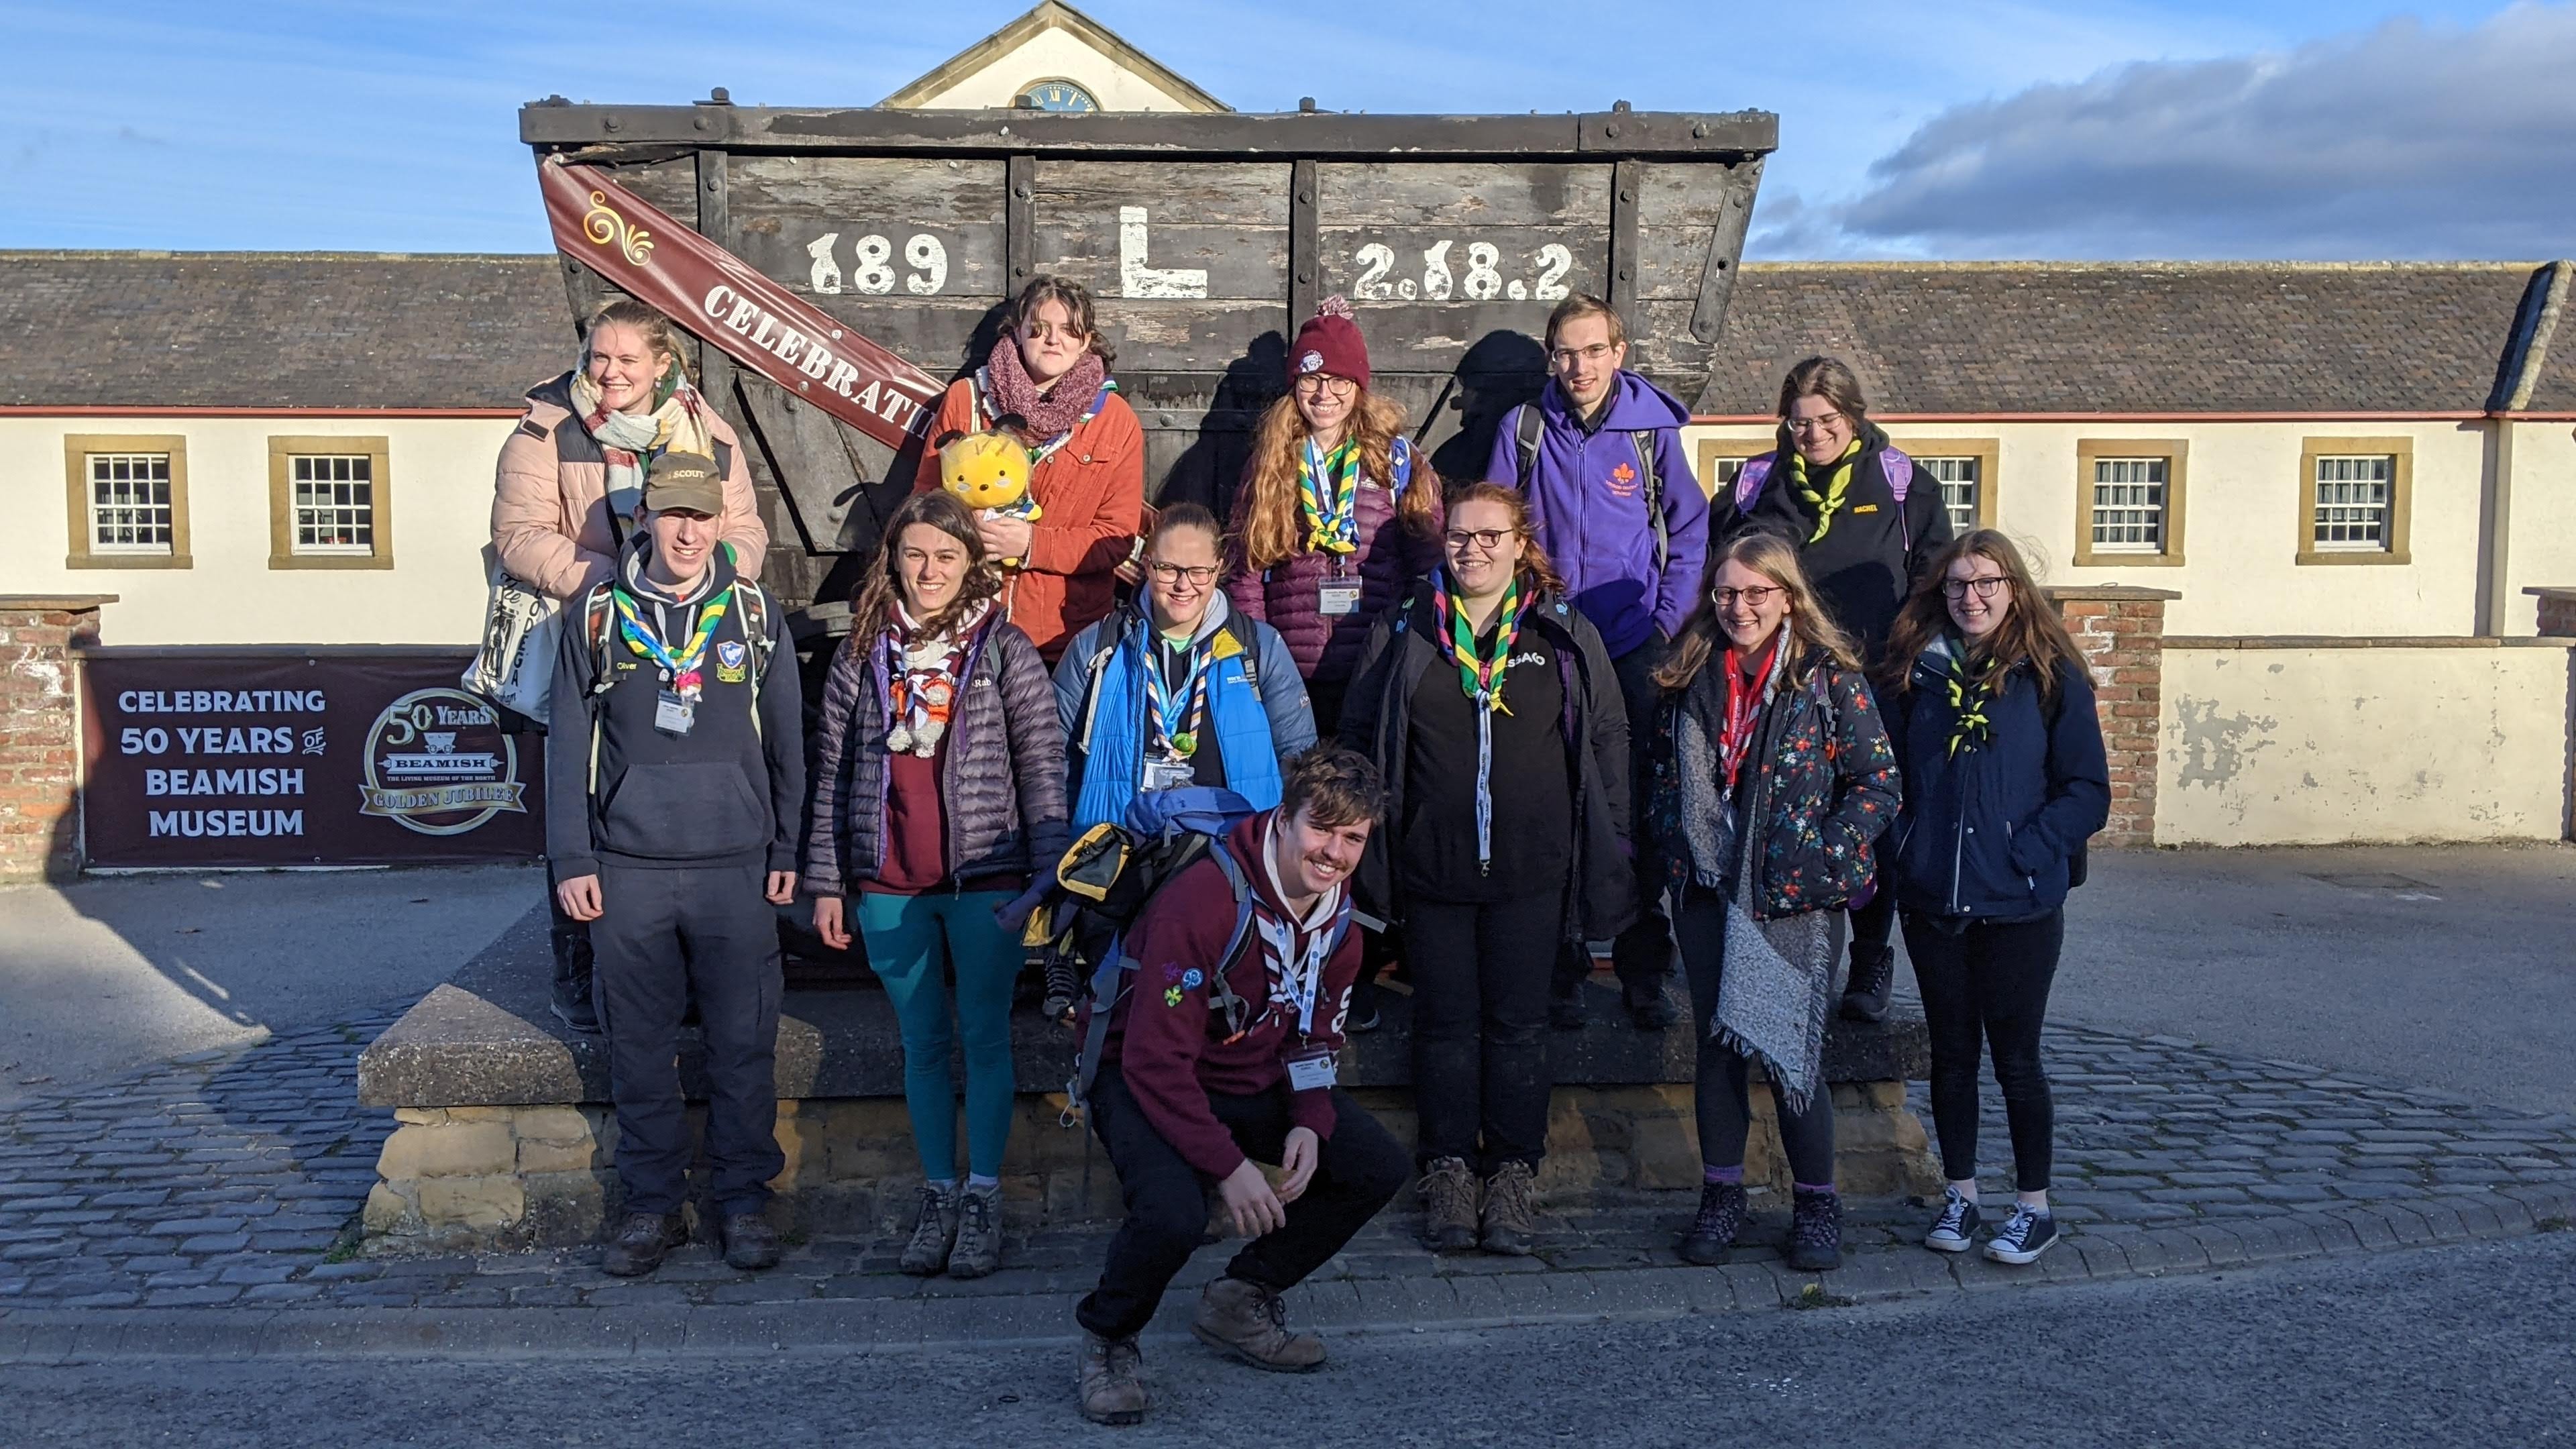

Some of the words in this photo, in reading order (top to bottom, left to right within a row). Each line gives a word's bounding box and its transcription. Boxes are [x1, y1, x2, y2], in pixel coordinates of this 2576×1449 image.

[806, 233, 948, 294] 189
[1120, 206, 1208, 299] L
[672, 470, 704, 479] SCOUT
[616, 662, 637, 670] Oliver
[973, 677, 991, 688] Rab
[119, 691, 326, 712] CELEBRATING
[386, 703, 433, 745] 50
[436, 706, 492, 725] YEARS
[121, 728, 168, 754] 50
[177, 727, 294, 754] YEARS
[303, 729, 325, 751] OF
[395, 759, 486, 768] BEAMISH
[146, 769, 304, 796] BEAMISH
[373, 793, 439, 809] GOLDEN
[443, 787, 514, 805] JUBILEE
[150, 810, 303, 837] MUSEUM
